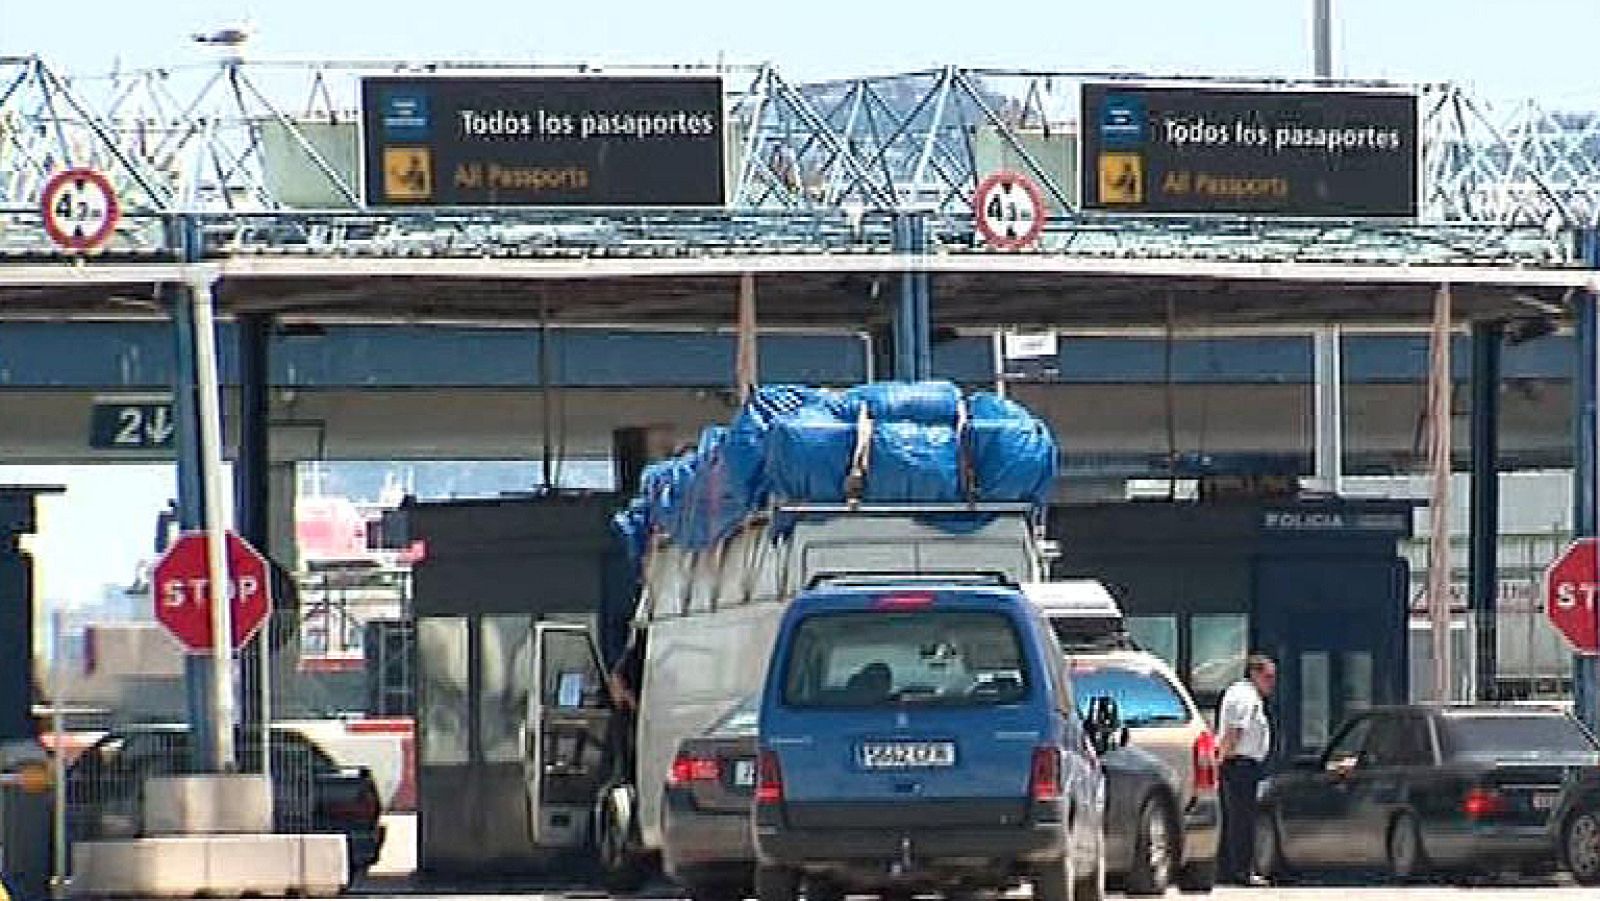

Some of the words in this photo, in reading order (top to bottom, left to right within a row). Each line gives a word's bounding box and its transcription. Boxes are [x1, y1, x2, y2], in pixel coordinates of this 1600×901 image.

[461, 109, 532, 135] Todos
[538, 109, 575, 135] los
[580, 109, 714, 139] pasaportes
[1165, 117, 1230, 143] Todos
[1236, 119, 1268, 146] los
[1276, 123, 1400, 152] pasaportes
[455, 162, 483, 189] All
[114, 407, 142, 443] 2
[162, 576, 258, 607] STP
